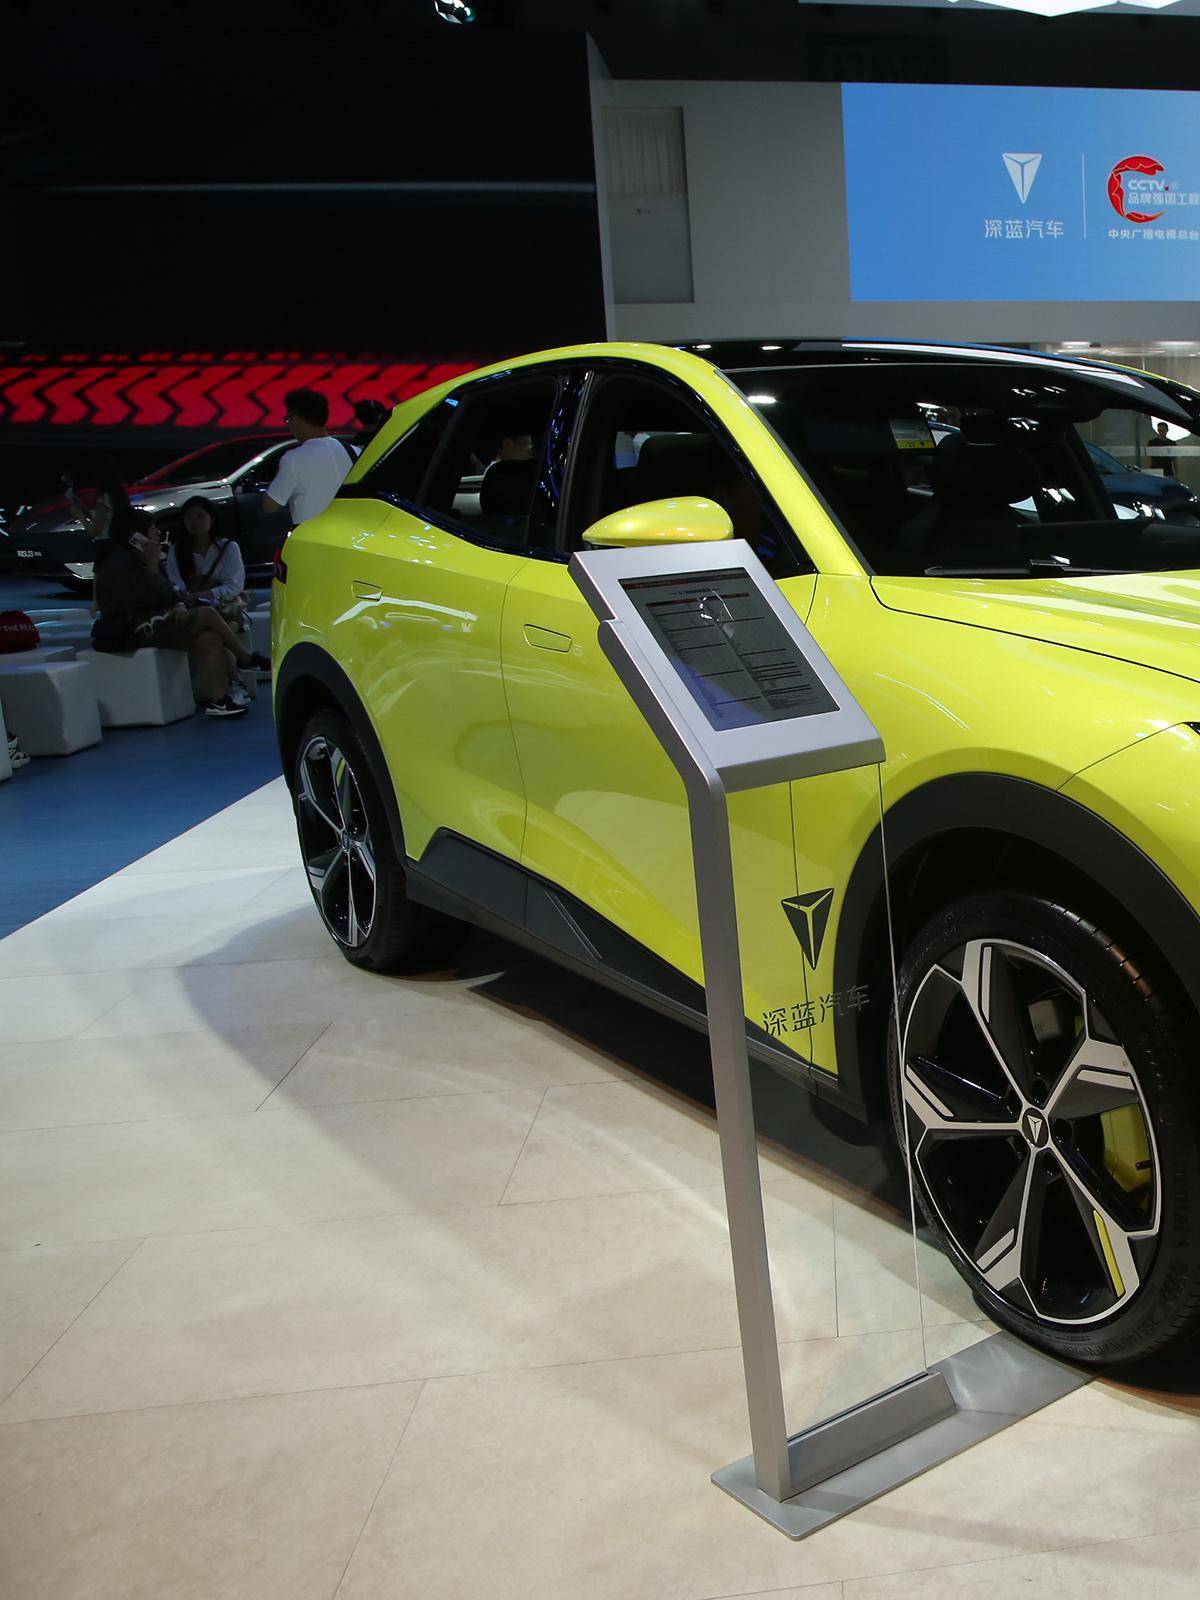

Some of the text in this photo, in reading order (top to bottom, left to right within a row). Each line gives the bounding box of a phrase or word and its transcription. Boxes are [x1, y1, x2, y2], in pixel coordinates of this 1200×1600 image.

[1128, 192, 1200, 205] 品牌强国工程
[984, 219, 1064, 239] 深蓝汽车
[1107, 229, 1200, 240] 中央广播电视总台
[762, 985, 870, 1036] 深蓝汽车
